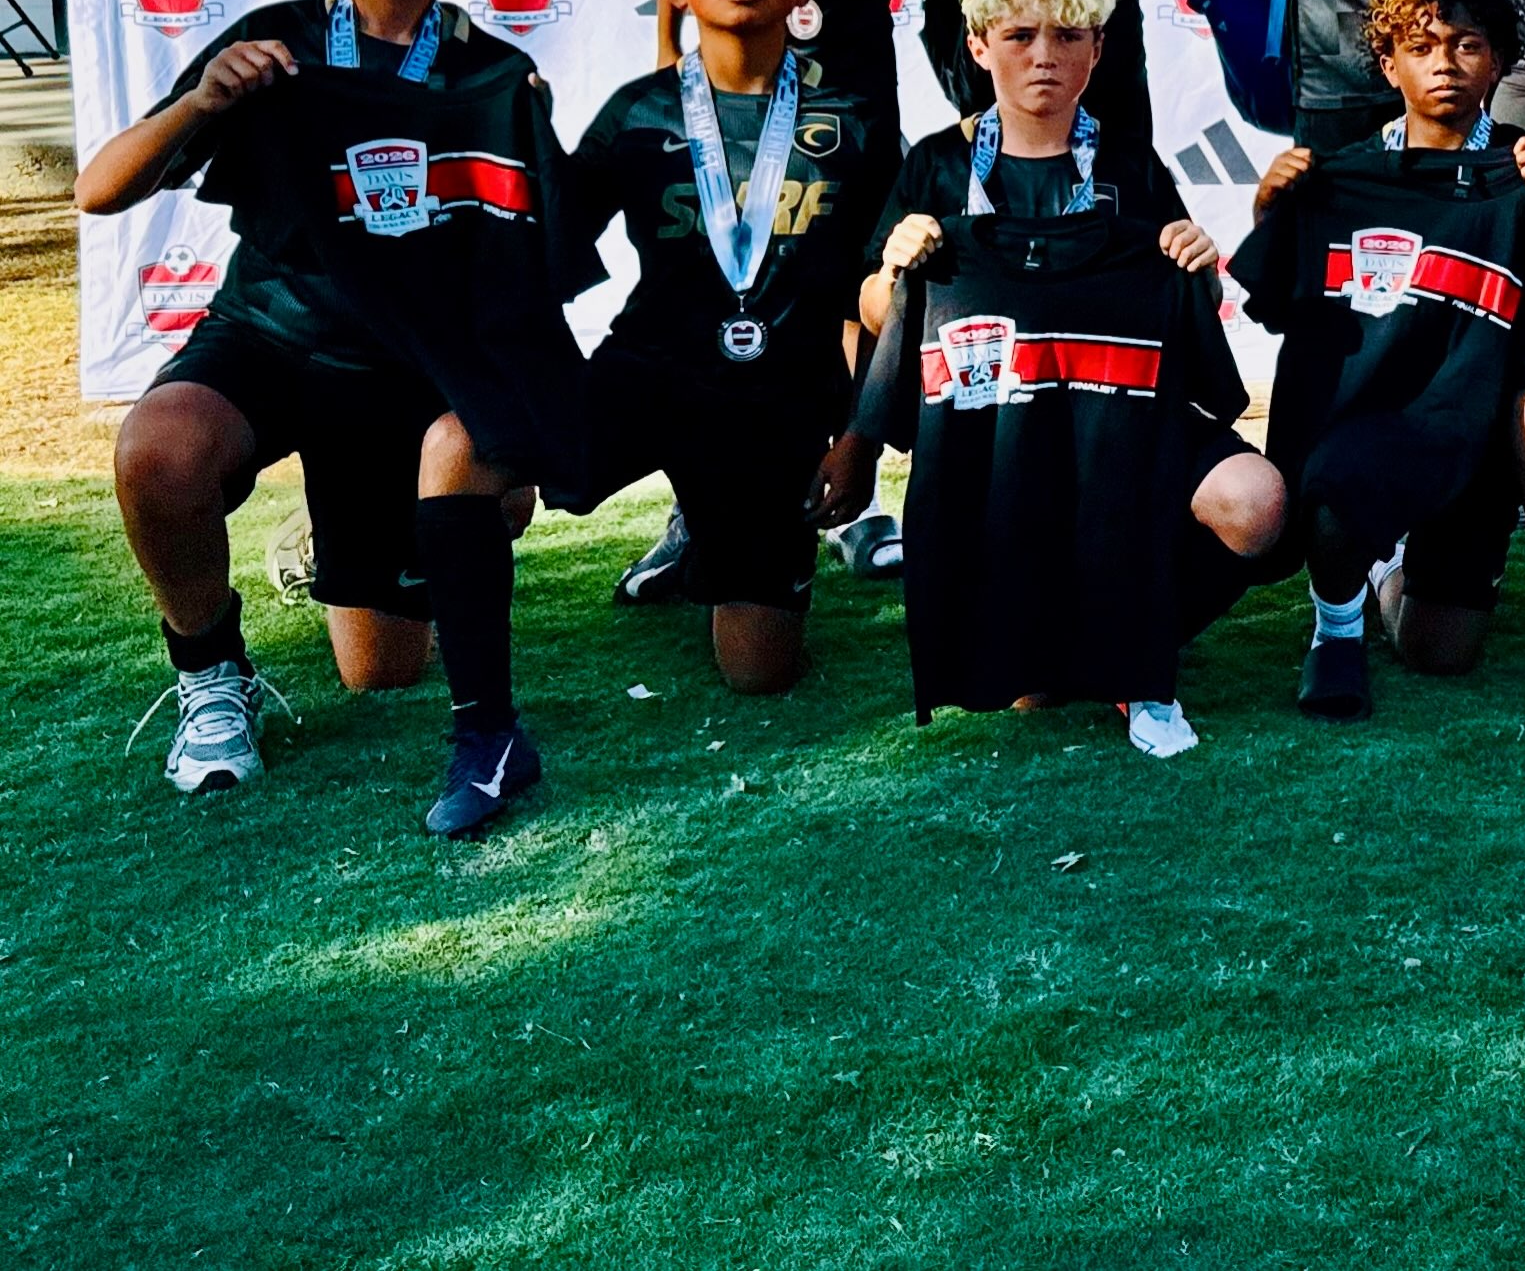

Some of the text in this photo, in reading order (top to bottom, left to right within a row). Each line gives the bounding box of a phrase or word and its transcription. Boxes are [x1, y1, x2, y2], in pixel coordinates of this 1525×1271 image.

[143, 15, 200, 23] LEGACY
[493, 13, 549, 21] LEGACY
[691, 105, 719, 169] FINALIST
[359, 151, 416, 165] 2026
[366, 173, 414, 185] DAVIS
[657, 180, 841, 239] SRF
[371, 210, 420, 222] LEGACY
[1362, 239, 1412, 251] 2026
[152, 293, 206, 303] DAVIS
[1068, 382, 1117, 394] FINALIST
